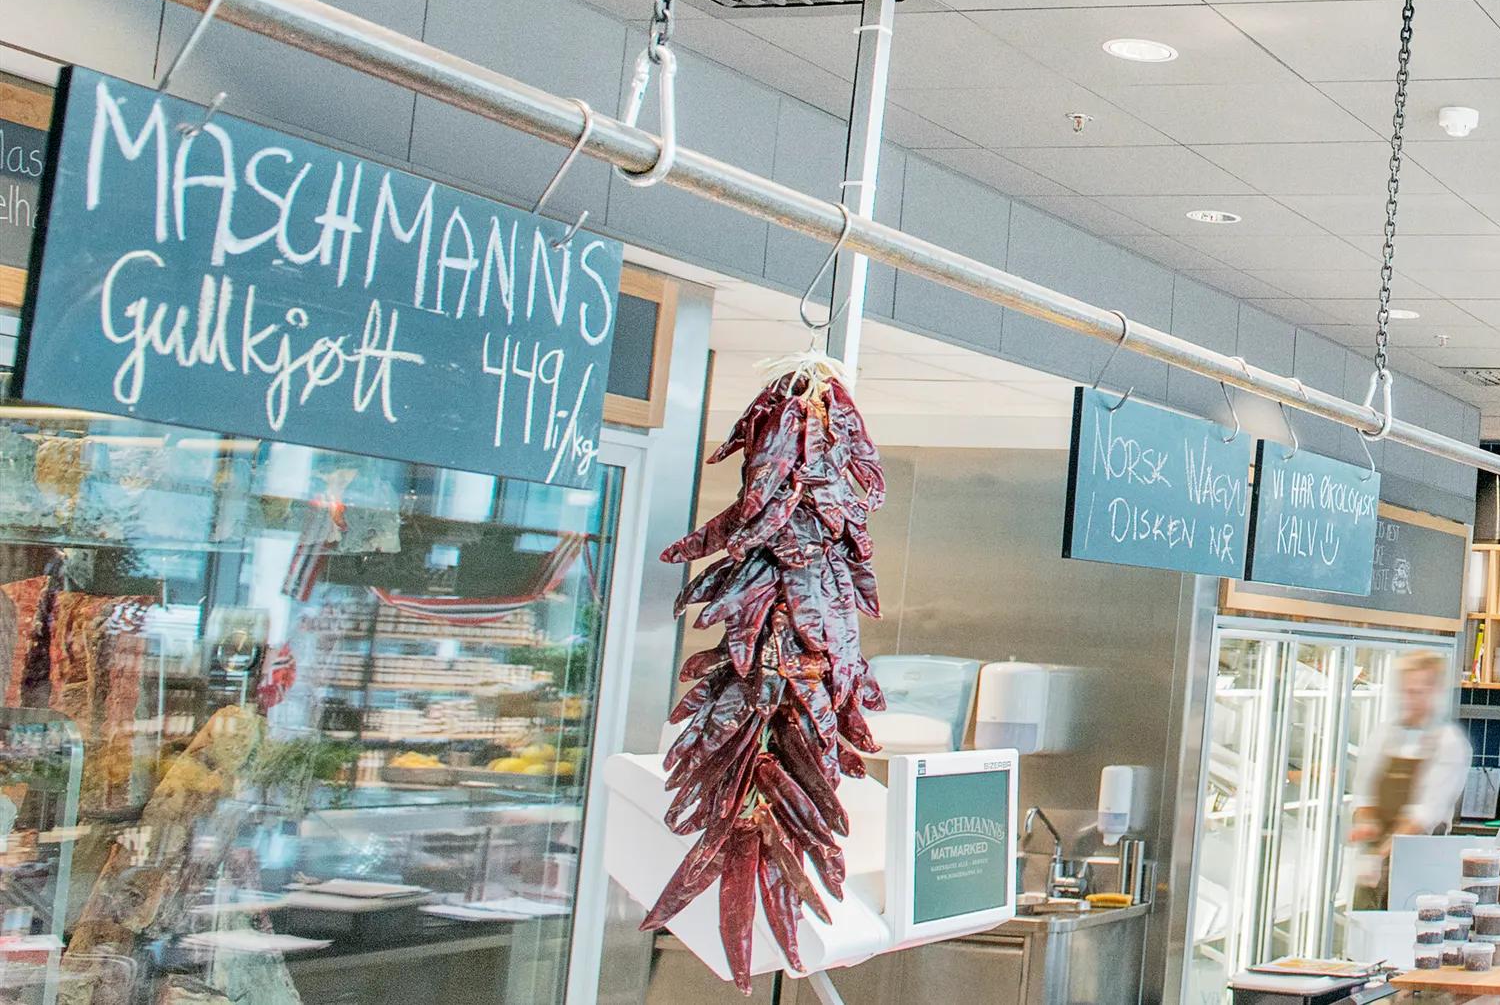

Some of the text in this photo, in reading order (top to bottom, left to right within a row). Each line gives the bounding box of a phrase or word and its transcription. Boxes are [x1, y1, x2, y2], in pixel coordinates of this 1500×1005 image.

[0, 128, 43, 177] as
[101, 249, 426, 432] Gullkjøtt
[1092, 406, 1247, 517] NORSK WAGYU
[1273, 469, 1285, 500] VI
[1291, 471, 1315, 510] HAR
[1108, 497, 1197, 549] DISKEN
[1277, 513, 1318, 557] KALV
[915, 816, 1006, 853] MASCHMANNS
[931, 841, 989, 861] MATMARKED
